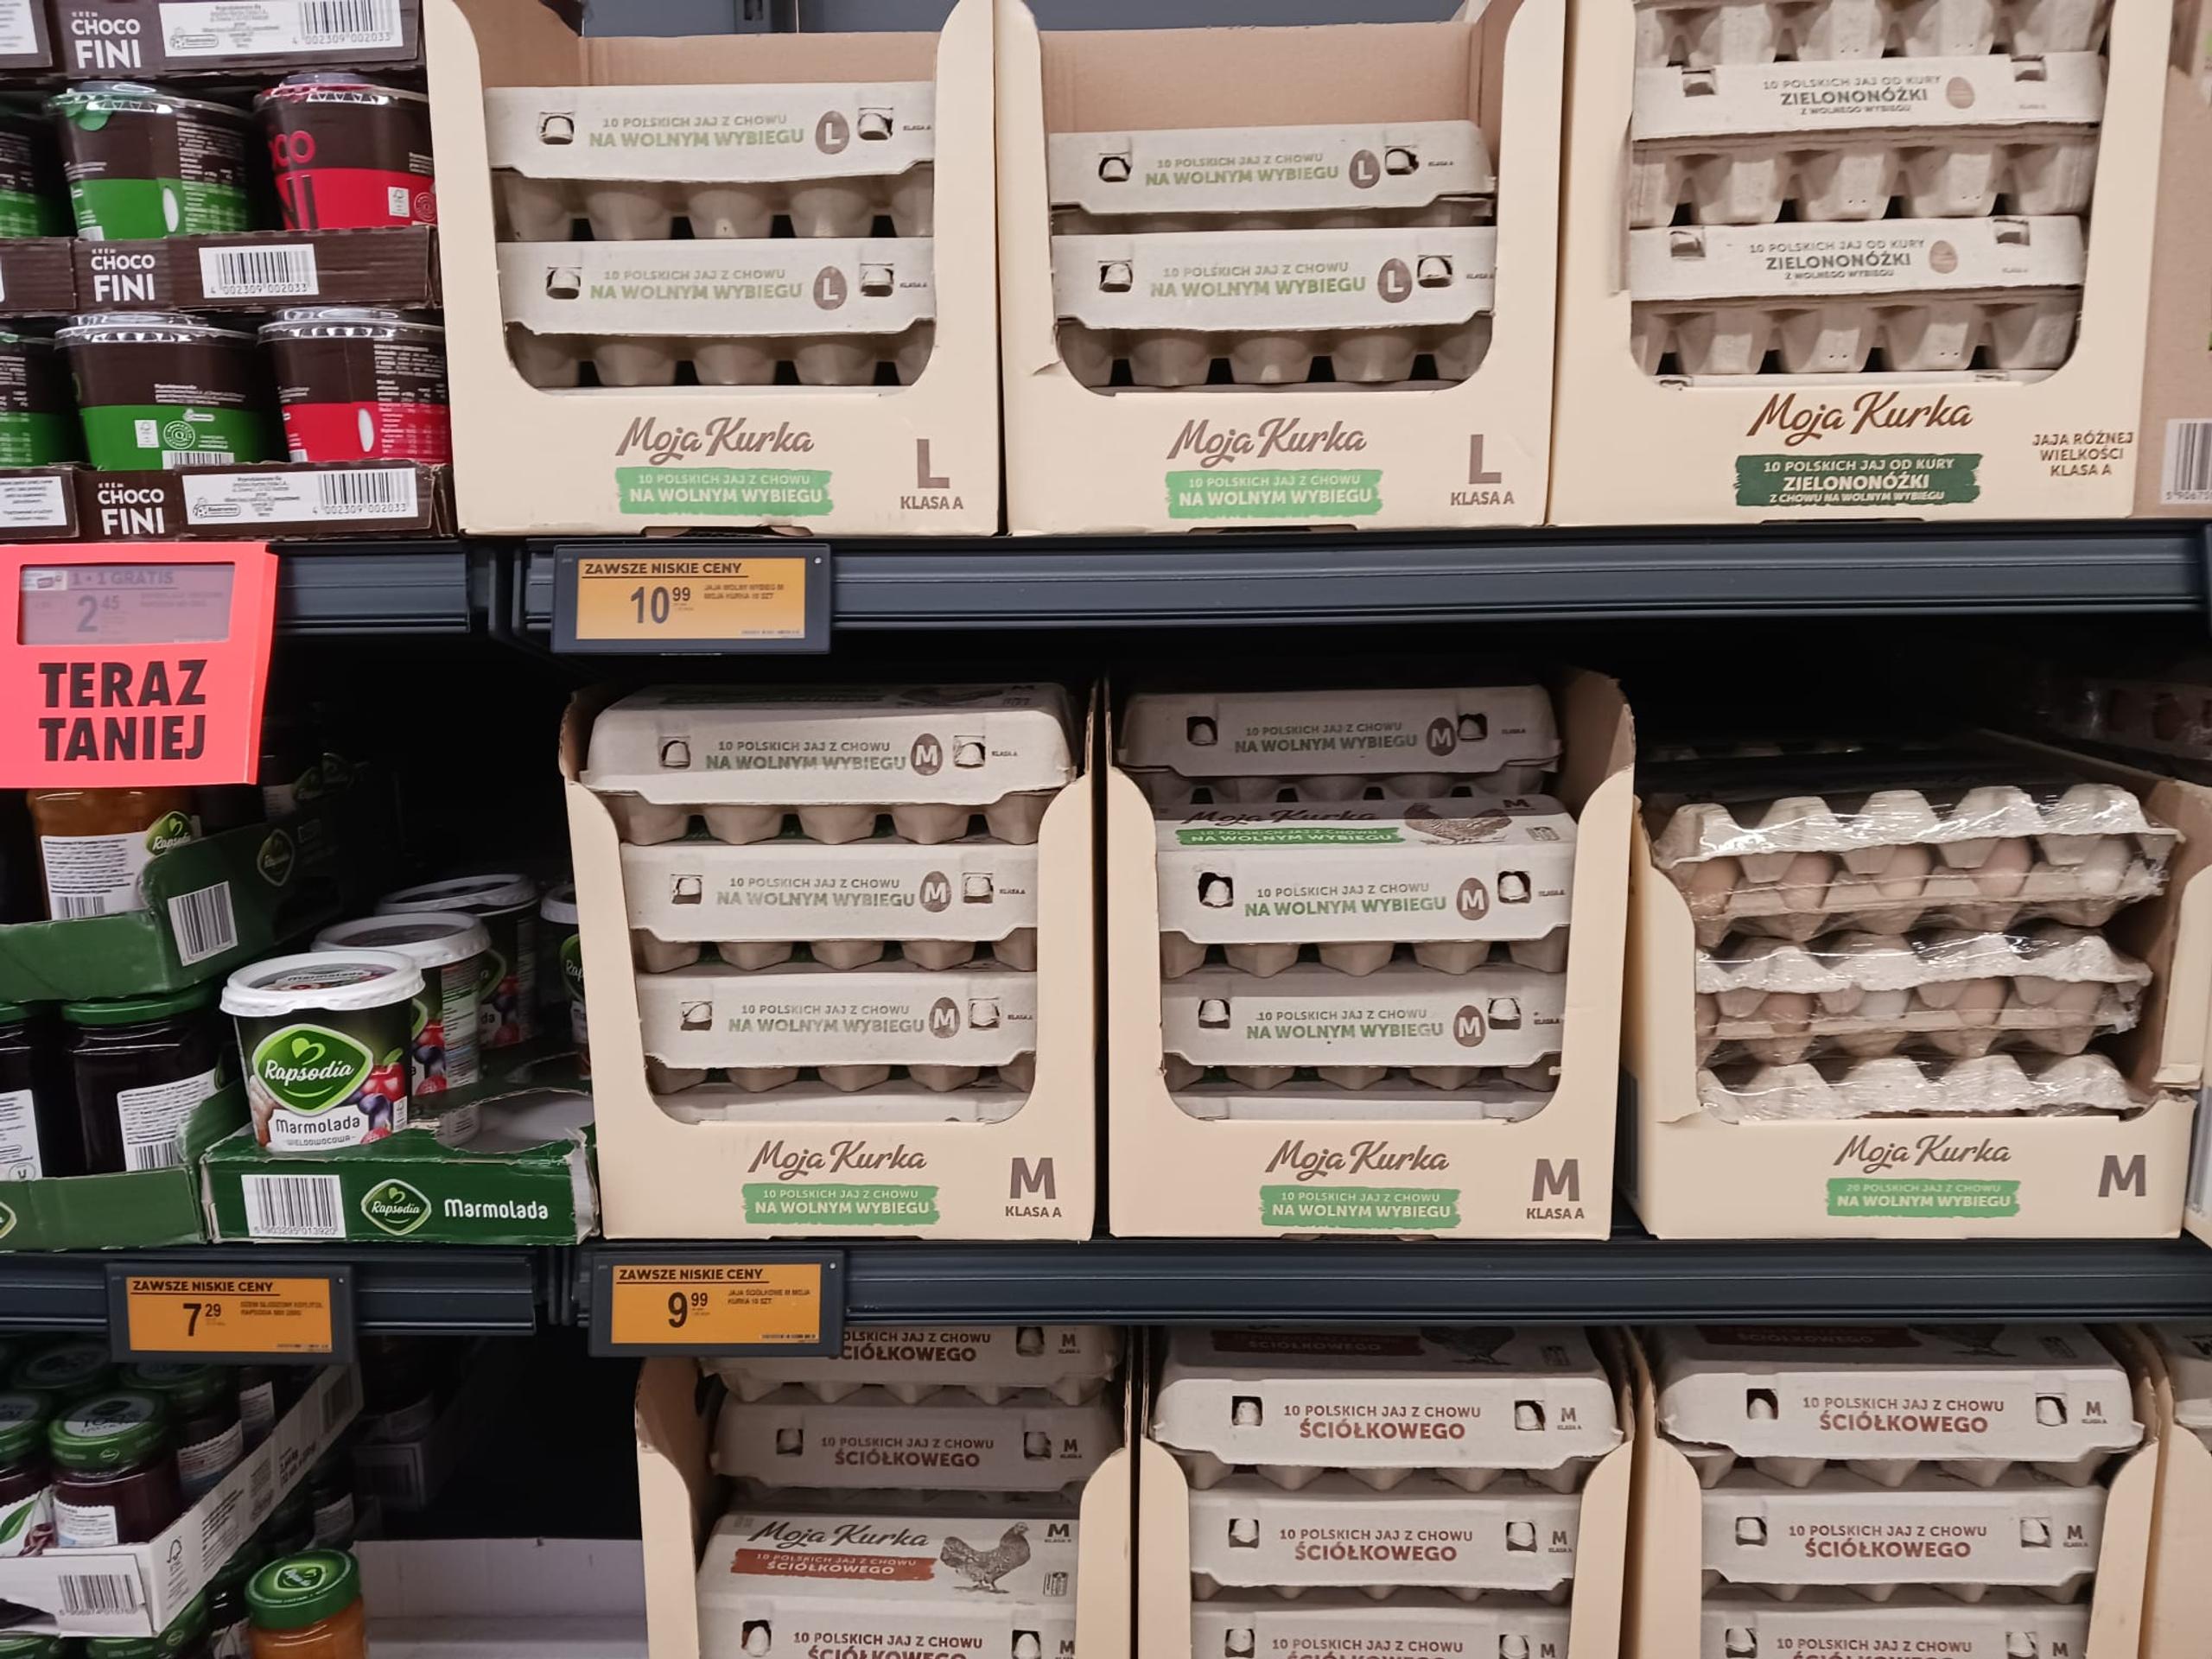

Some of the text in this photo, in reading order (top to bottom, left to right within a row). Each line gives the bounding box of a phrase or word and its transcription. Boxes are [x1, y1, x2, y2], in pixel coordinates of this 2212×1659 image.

[71, 18, 140, 35] CHOCO
[74, 39, 141, 68] FINI
[1780, 87, 1927, 106] ZIELONONÓŻKI
[602, 114, 786, 128] 10 POLSKICH JAJ Z CHOWU
[588, 128, 804, 147] NA WOLNYM WYBIEGU
[825, 123, 841, 144] L
[90, 252, 156, 270] CHOCO
[93, 273, 155, 301] FINI
[1746, 391, 1972, 446] Moja Kurka
[615, 416, 814, 467] Moja Kurka
[1166, 417, 1366, 467] Moja Kurka
[2031, 430, 2134, 446] JAJA RÓŻNEJ
[1468, 434, 1501, 484] L
[2040, 445, 2124, 461] WIELKOŚCI
[916, 438, 950, 488] L
[1764, 458, 1955, 474] 10 POLSKICH JAJ OD KURY
[2050, 463, 2112, 476] KLASA A
[638, 474, 810, 484] 10 POLSKICH JAJ Z CHOWU
[1188, 474, 1360, 488] 10 POLSKICH JAJ Z CHOWU
[1782, 472, 1929, 493] ZIELONONÓŻKI
[97, 486, 164, 504] CHOCO
[629, 486, 823, 502] NA WOLNYM WYBIEGU
[899, 495, 963, 509] KLASA A
[1179, 488, 1372, 505] NA WOLNYM WYBIEGU
[1450, 491, 1514, 505] KLASA A
[1770, 490, 1944, 503] Z CHOWU NA WOLNYM WYBIEGU
[100, 507, 164, 534] FINI
[585, 563, 741, 575] ZAWSZE NISKIE CENY
[630, 586, 671, 623] 10
[671, 586, 690, 605] 99
[78, 595, 98, 632] 2
[39, 659, 207, 708] TERAZ
[39, 715, 206, 760] TANIEJ
[1257, 883, 1428, 898] 10 POLSKICH JAJ Z CHOWU
[1244, 897, 1446, 917] NA WOLNYM WYBIEGU
[1463, 889, 1485, 911] M
[264, 1060, 353, 1086] Rapsodia
[276, 1112, 361, 1133] Marmolada
[747, 1141, 926, 1183] Moja Kurka
[1264, 1140, 1449, 1180] Moja Kurka
[1833, 1135, 2011, 1173] Moja Kurka
[1009, 1157, 1056, 1198] M
[1531, 1159, 1580, 1201] M
[2098, 1154, 2145, 1197] M
[763, 1189, 918, 1198] 10 POLSKICH JAJ Z CHOWU
[1846, 1183, 2001, 1192] 20 POLSKICH JAJ Z CHOWU
[754, 1198, 931, 1213] NA WOLNYM WYBIEGU
[1281, 1192, 1440, 1203] 10 POLSKICH JAJ Z CHOWU
[1836, 1193, 2012, 1206] NA WOLNYM WYBIEGU
[372, 1200, 420, 1217] Rapsodia
[443, 1198, 548, 1218] Marmolada
[1005, 1205, 1062, 1217] KLASA A
[1272, 1204, 1452, 1217] NA WOLNYM WYBIEGU
[1526, 1207, 1585, 1219] KLASA A
[620, 1269, 763, 1280] ZAWSZE NISKIE CENY
[133, 1281, 272, 1292] ZAWSZE NISKIE CENY
[667, 1292, 688, 1327] 9
[690, 1292, 708, 1309] 99
[182, 1302, 201, 1336] 7
[204, 1303, 221, 1317] 29
[1283, 1404, 1480, 1417] 10 POLSKICH JAJ Z CHOWU
[1560, 1407, 1576, 1422] M
[1299, 1419, 1465, 1439] ŚCIÓŁKOWEGO
[821, 1436, 994, 1449] 10 POLSKICH JAJ Z CHOWU
[1064, 1440, 1077, 1452] M
[834, 1448, 980, 1466] ŚCIÓŁKOWEGO
[1789, 1524, 1986, 1536] 10 POLSKICH JAJ Z CHOWU
[2067, 1524, 2083, 1540] M
[1804, 1538, 1971, 1557] ŚCIÓŁKOWEGO
